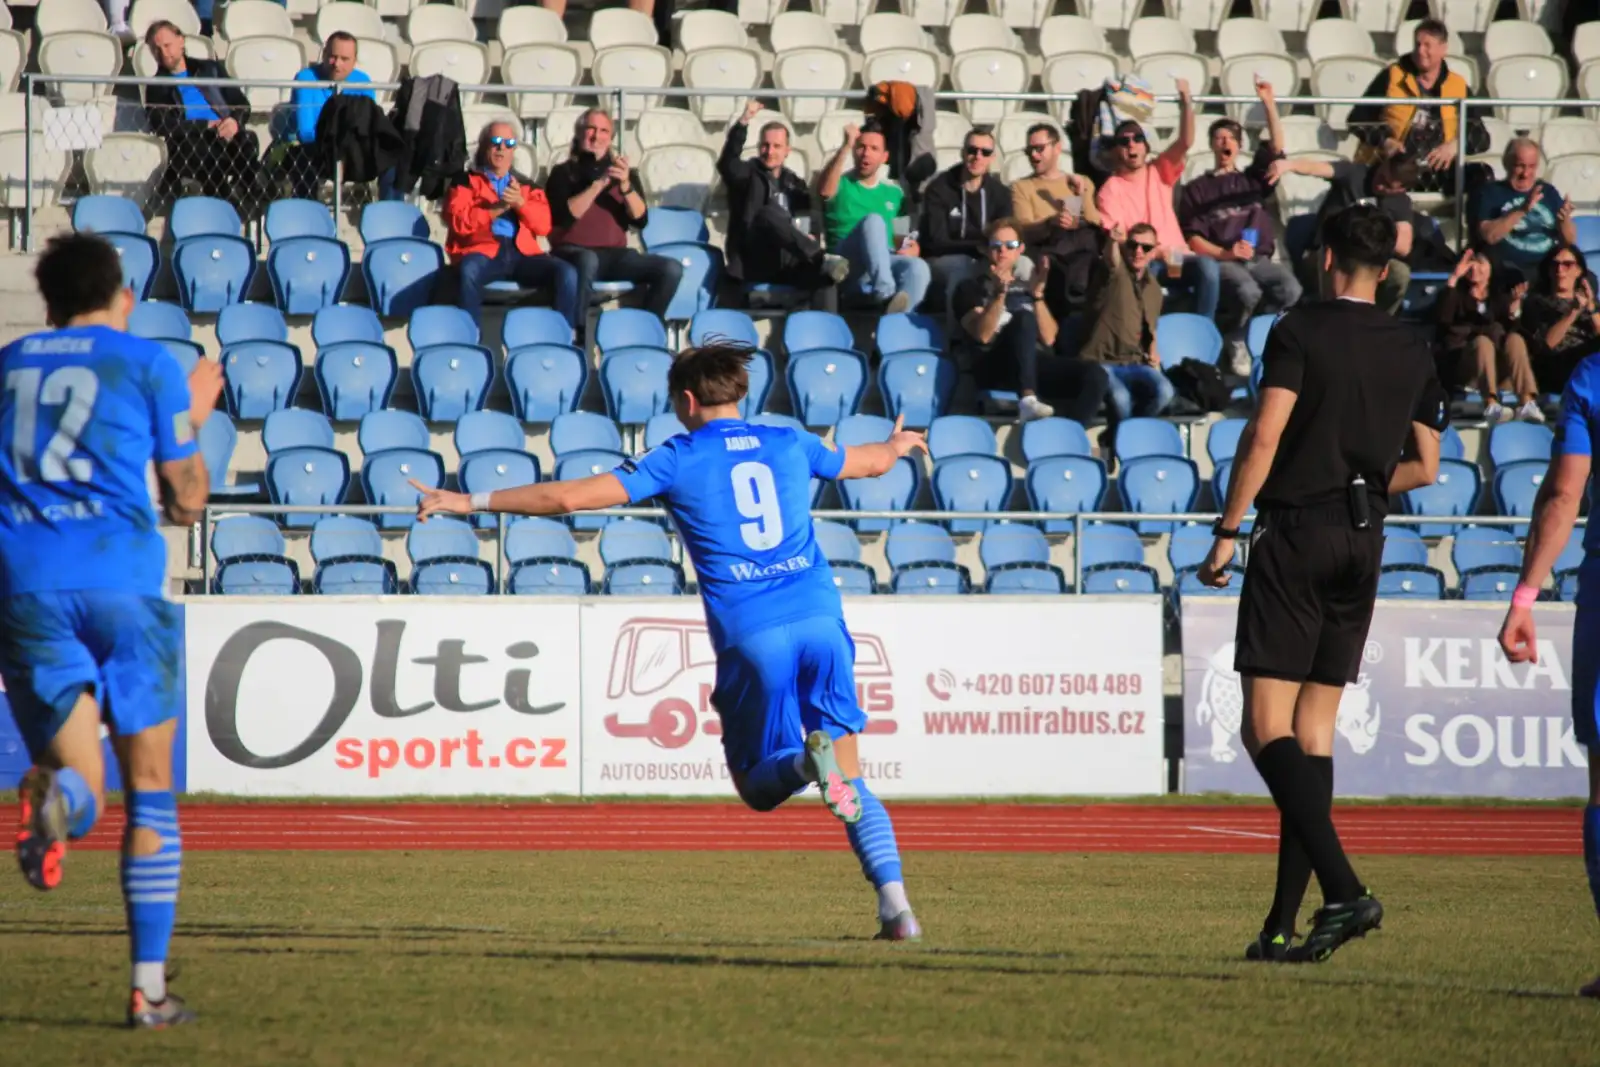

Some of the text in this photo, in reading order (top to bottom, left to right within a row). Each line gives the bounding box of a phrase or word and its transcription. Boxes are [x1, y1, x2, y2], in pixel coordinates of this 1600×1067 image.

[6, 366, 98, 484] 12
[730, 461, 783, 551] 9
[205, 619, 566, 769] Olti
[962, 673, 1142, 695] +420 607 504 489
[923, 706, 1145, 735] www.mirabus.cz
[335, 729, 567, 778] sport.cz
[600, 758, 713, 780] AUTOBUSOVÁ
